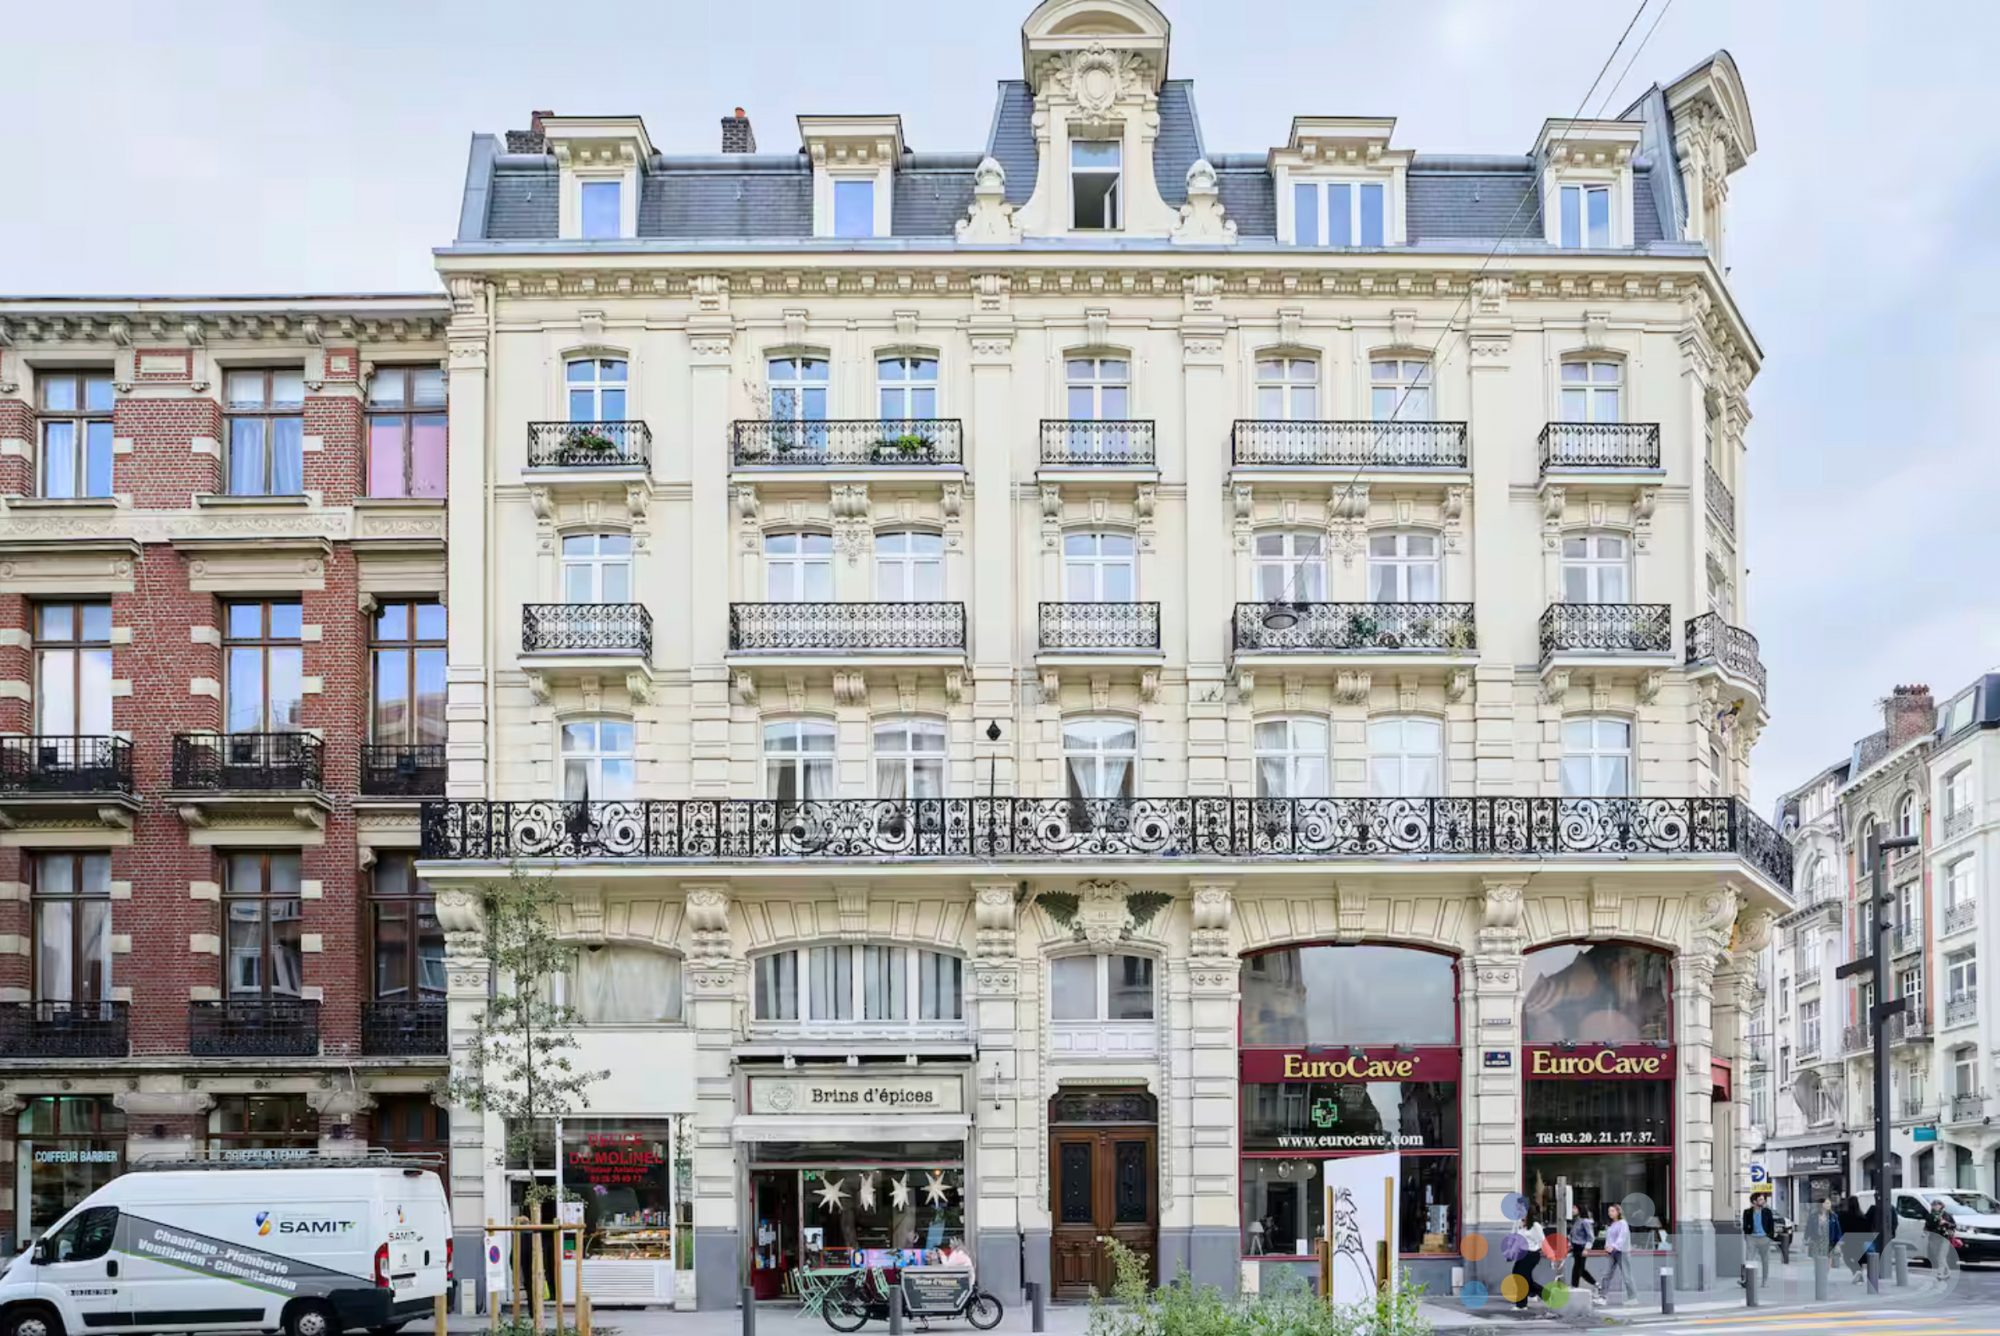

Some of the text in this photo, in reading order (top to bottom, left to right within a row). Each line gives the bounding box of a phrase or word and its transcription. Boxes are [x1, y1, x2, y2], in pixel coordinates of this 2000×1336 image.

[811, 1087, 934, 1106] Brins d'épices
[1277, 1134, 1424, 1147] www.eurocave.com
[35, 1150, 118, 1164] COIFFEUR BARBIER
[279, 1221, 351, 1233] SAMIT
[138, 1238, 206, 1267] Ventilation
[154, 1229, 217, 1256] Chauffage
[226, 1248, 289, 1275] Plomberie
